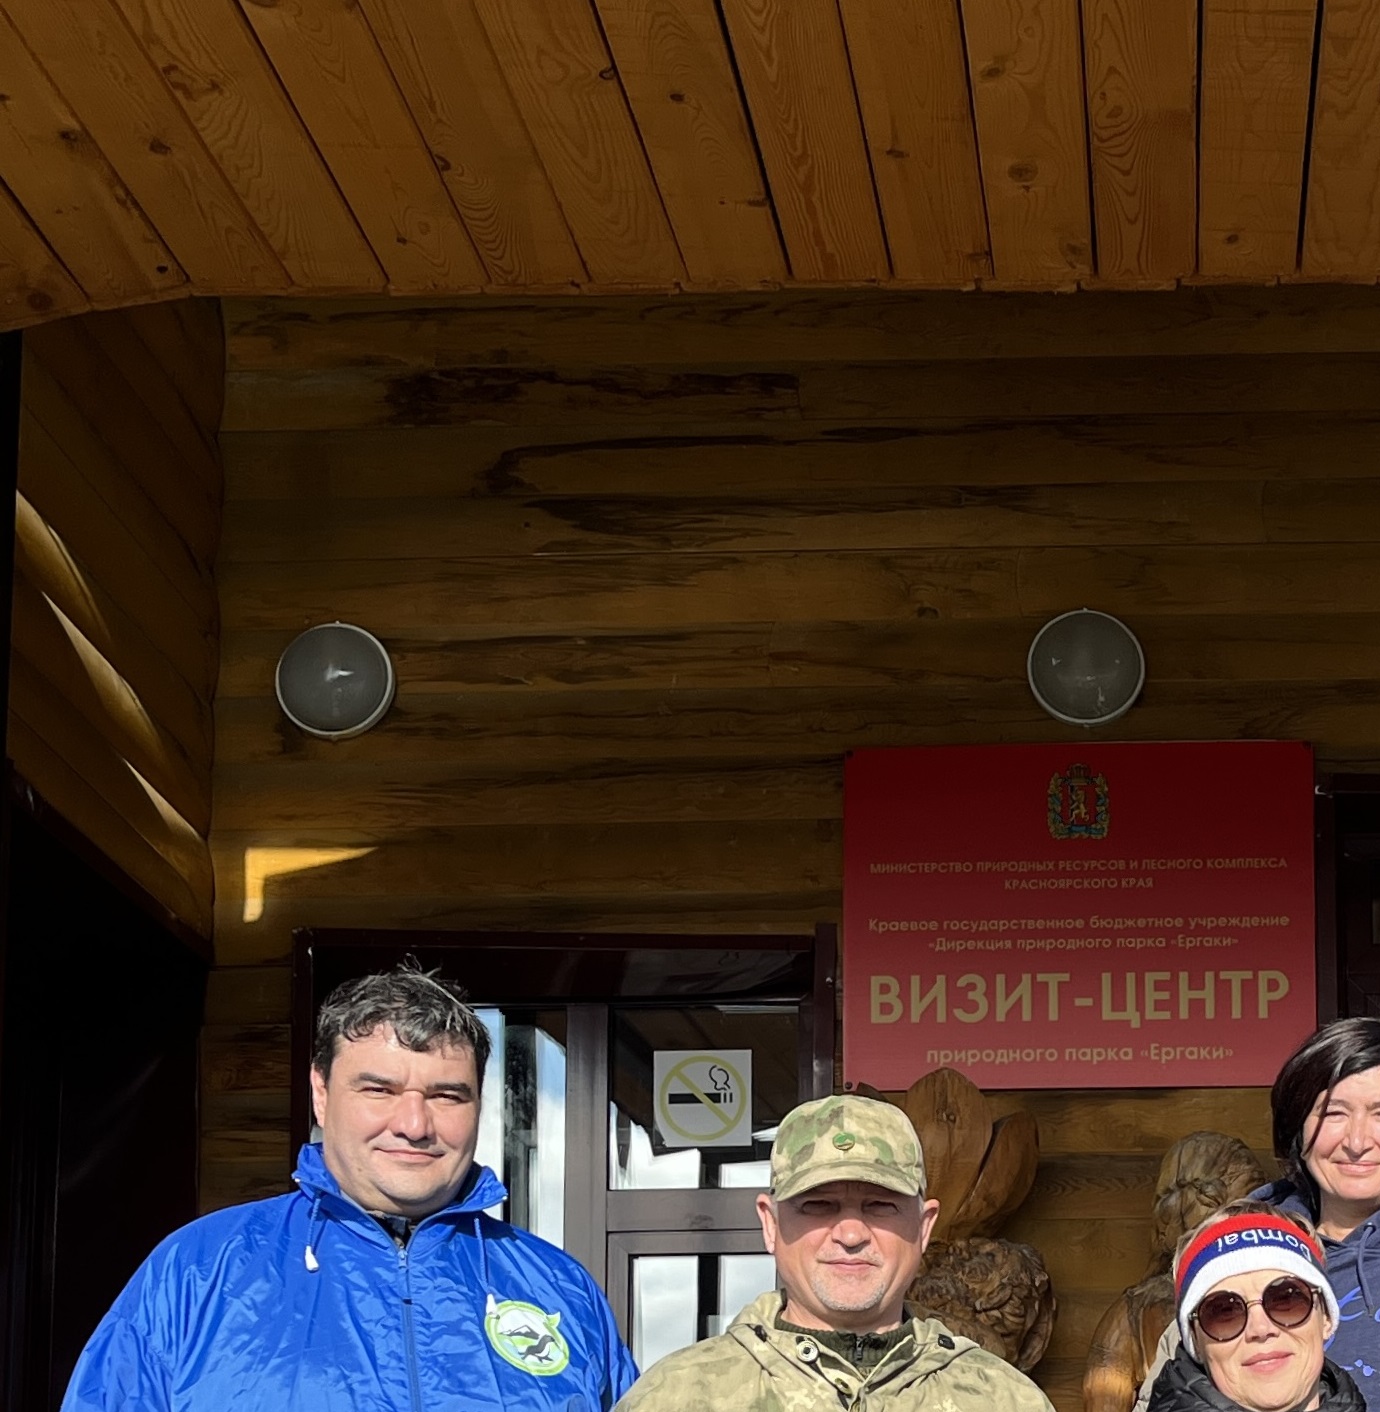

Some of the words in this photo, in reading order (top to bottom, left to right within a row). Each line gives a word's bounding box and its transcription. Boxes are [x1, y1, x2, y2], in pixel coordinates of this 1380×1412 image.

[870, 862, 973, 874] МИНИСТЕРСТВО
[976, 860, 1055, 874] ПРИРОДНЫХ
[1058, 859, 1126, 872] РЕСУРСОВ
[1129, 859, 1138, 870] И
[1141, 858, 1203, 870] ЛЕСНОГО
[1206, 857, 1288, 870] КОМПЛЕКСА
[1004, 877, 1118, 890] КРАСНОЯРСКОГО
[1121, 877, 1154, 889] КРАЯ
[868, 918, 939, 933] Краевое
[943, 918, 1085, 933] государственное
[1089, 915, 1184, 930] бюджетное
[1188, 914, 1290, 930] учреждение
[1016, 936, 1112, 952] природного
[1116, 936, 1167, 950] парка
[1170, 934, 1239, 950] «Ергаки»
[870, 970, 1290, 1028] ВИЗИТ-ЦЕНТР
[926, 1048, 1058, 1066] природного
[1064, 1046, 1133, 1064] парка
[1140, 1043, 1234, 1064] «Ергаки»
